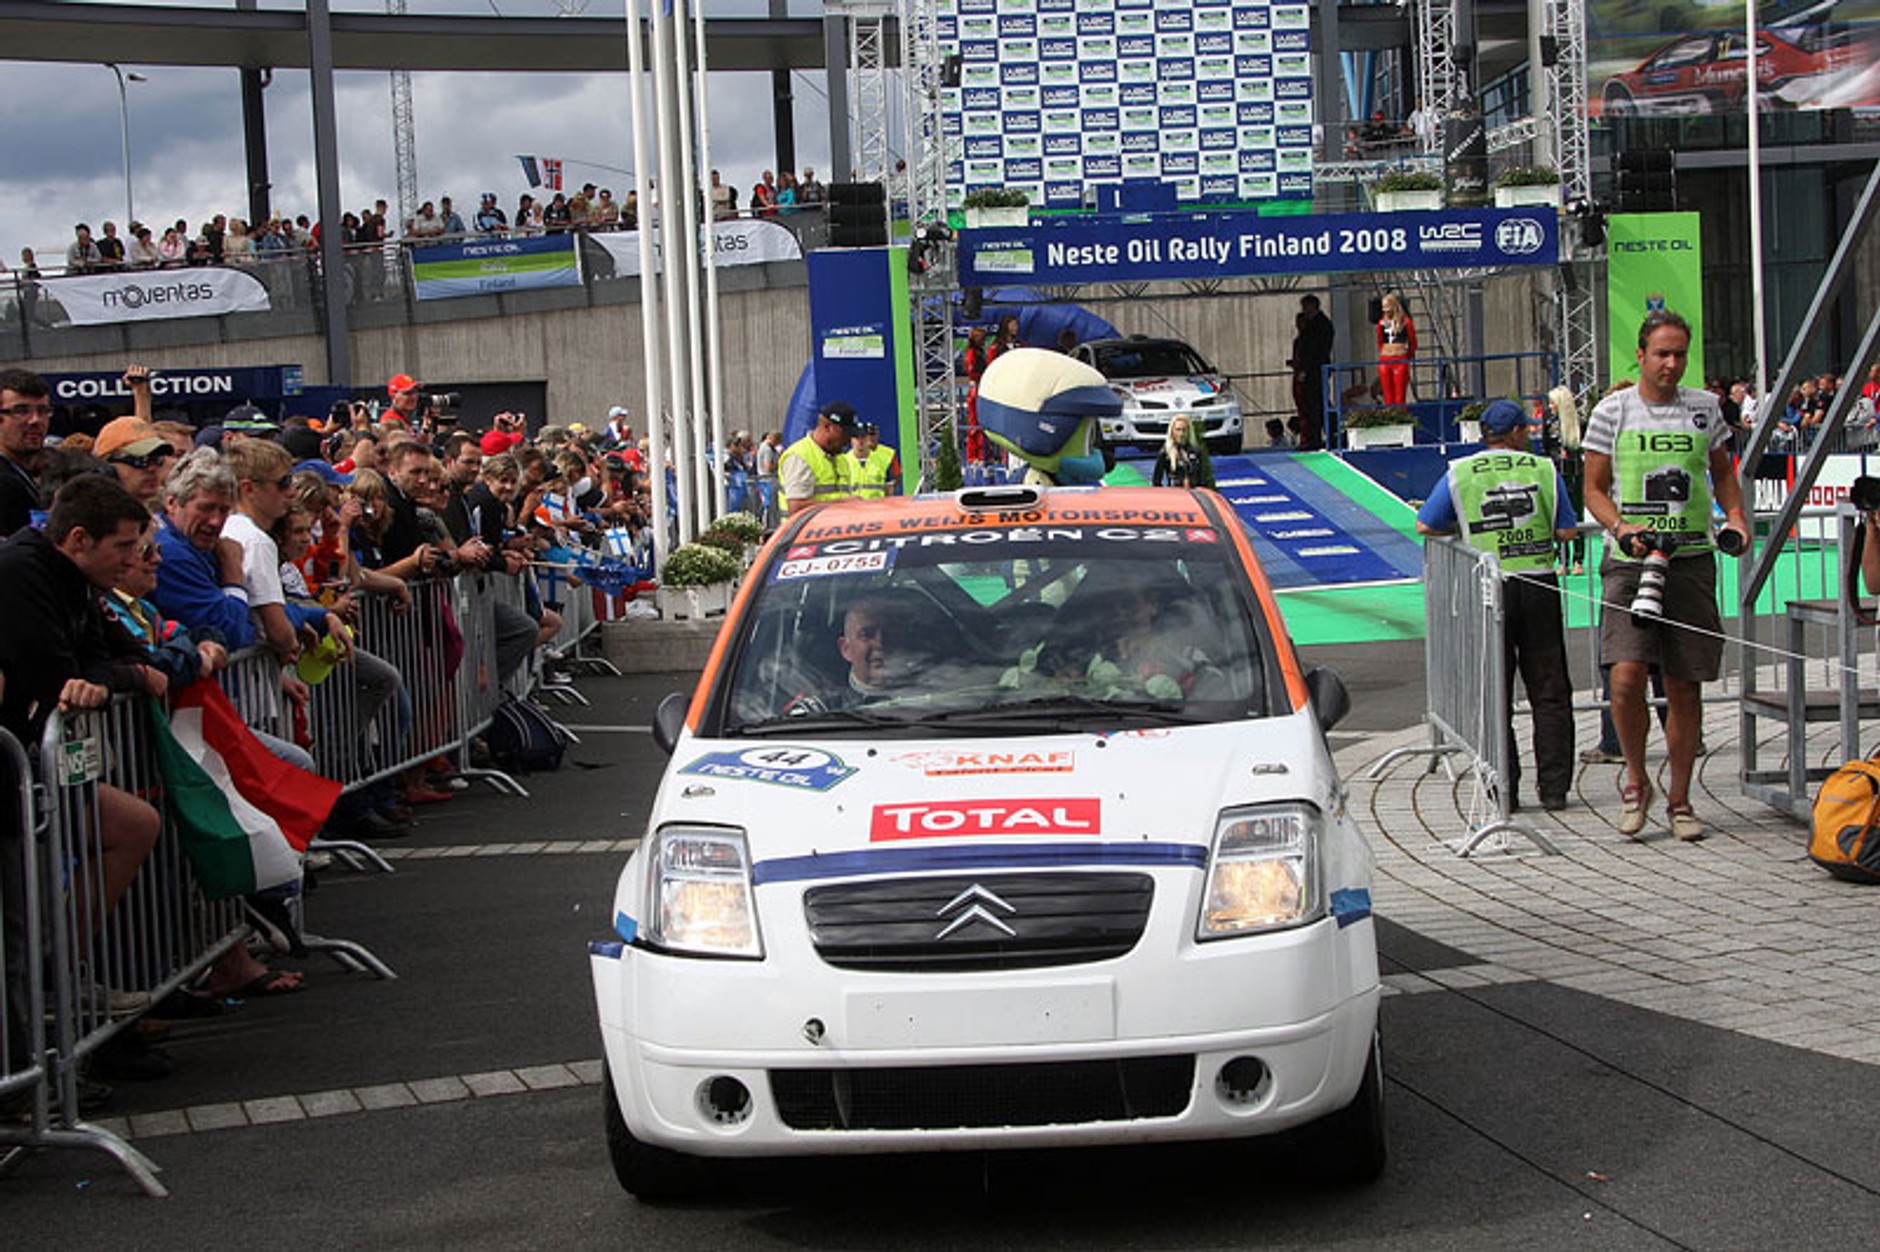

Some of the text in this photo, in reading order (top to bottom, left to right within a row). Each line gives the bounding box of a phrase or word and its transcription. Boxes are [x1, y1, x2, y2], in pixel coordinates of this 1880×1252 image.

[1420, 223, 1482, 239] WRC
[1499, 225, 1538, 246] FIA
[1048, 243, 1120, 266] Neste
[1127, 239, 1160, 262] Oil
[1169, 237, 1231, 265] Rally
[1240, 231, 1330, 259] Finland
[1339, 229, 1407, 253] 2008
[1614, 239, 1693, 252] NESTE OIL
[103, 283, 214, 308] moventas
[57, 375, 232, 398] COLLCTION
[1638, 434, 1693, 452] 163
[1472, 456, 1538, 473] 234
[805, 510, 1199, 539] HANS WEIJS MOTORSPORT
[1647, 517, 1688, 530] 2008
[823, 528, 1180, 553] CITROËN C2
[1497, 529, 1534, 544] 2008
[781, 555, 883, 577] CJ-0755
[759, 751, 811, 765] 44
[957, 752, 1070, 766] KNAF
[698, 763, 813, 786] NESTE OIL
[883, 806, 1091, 833] TOTAL
